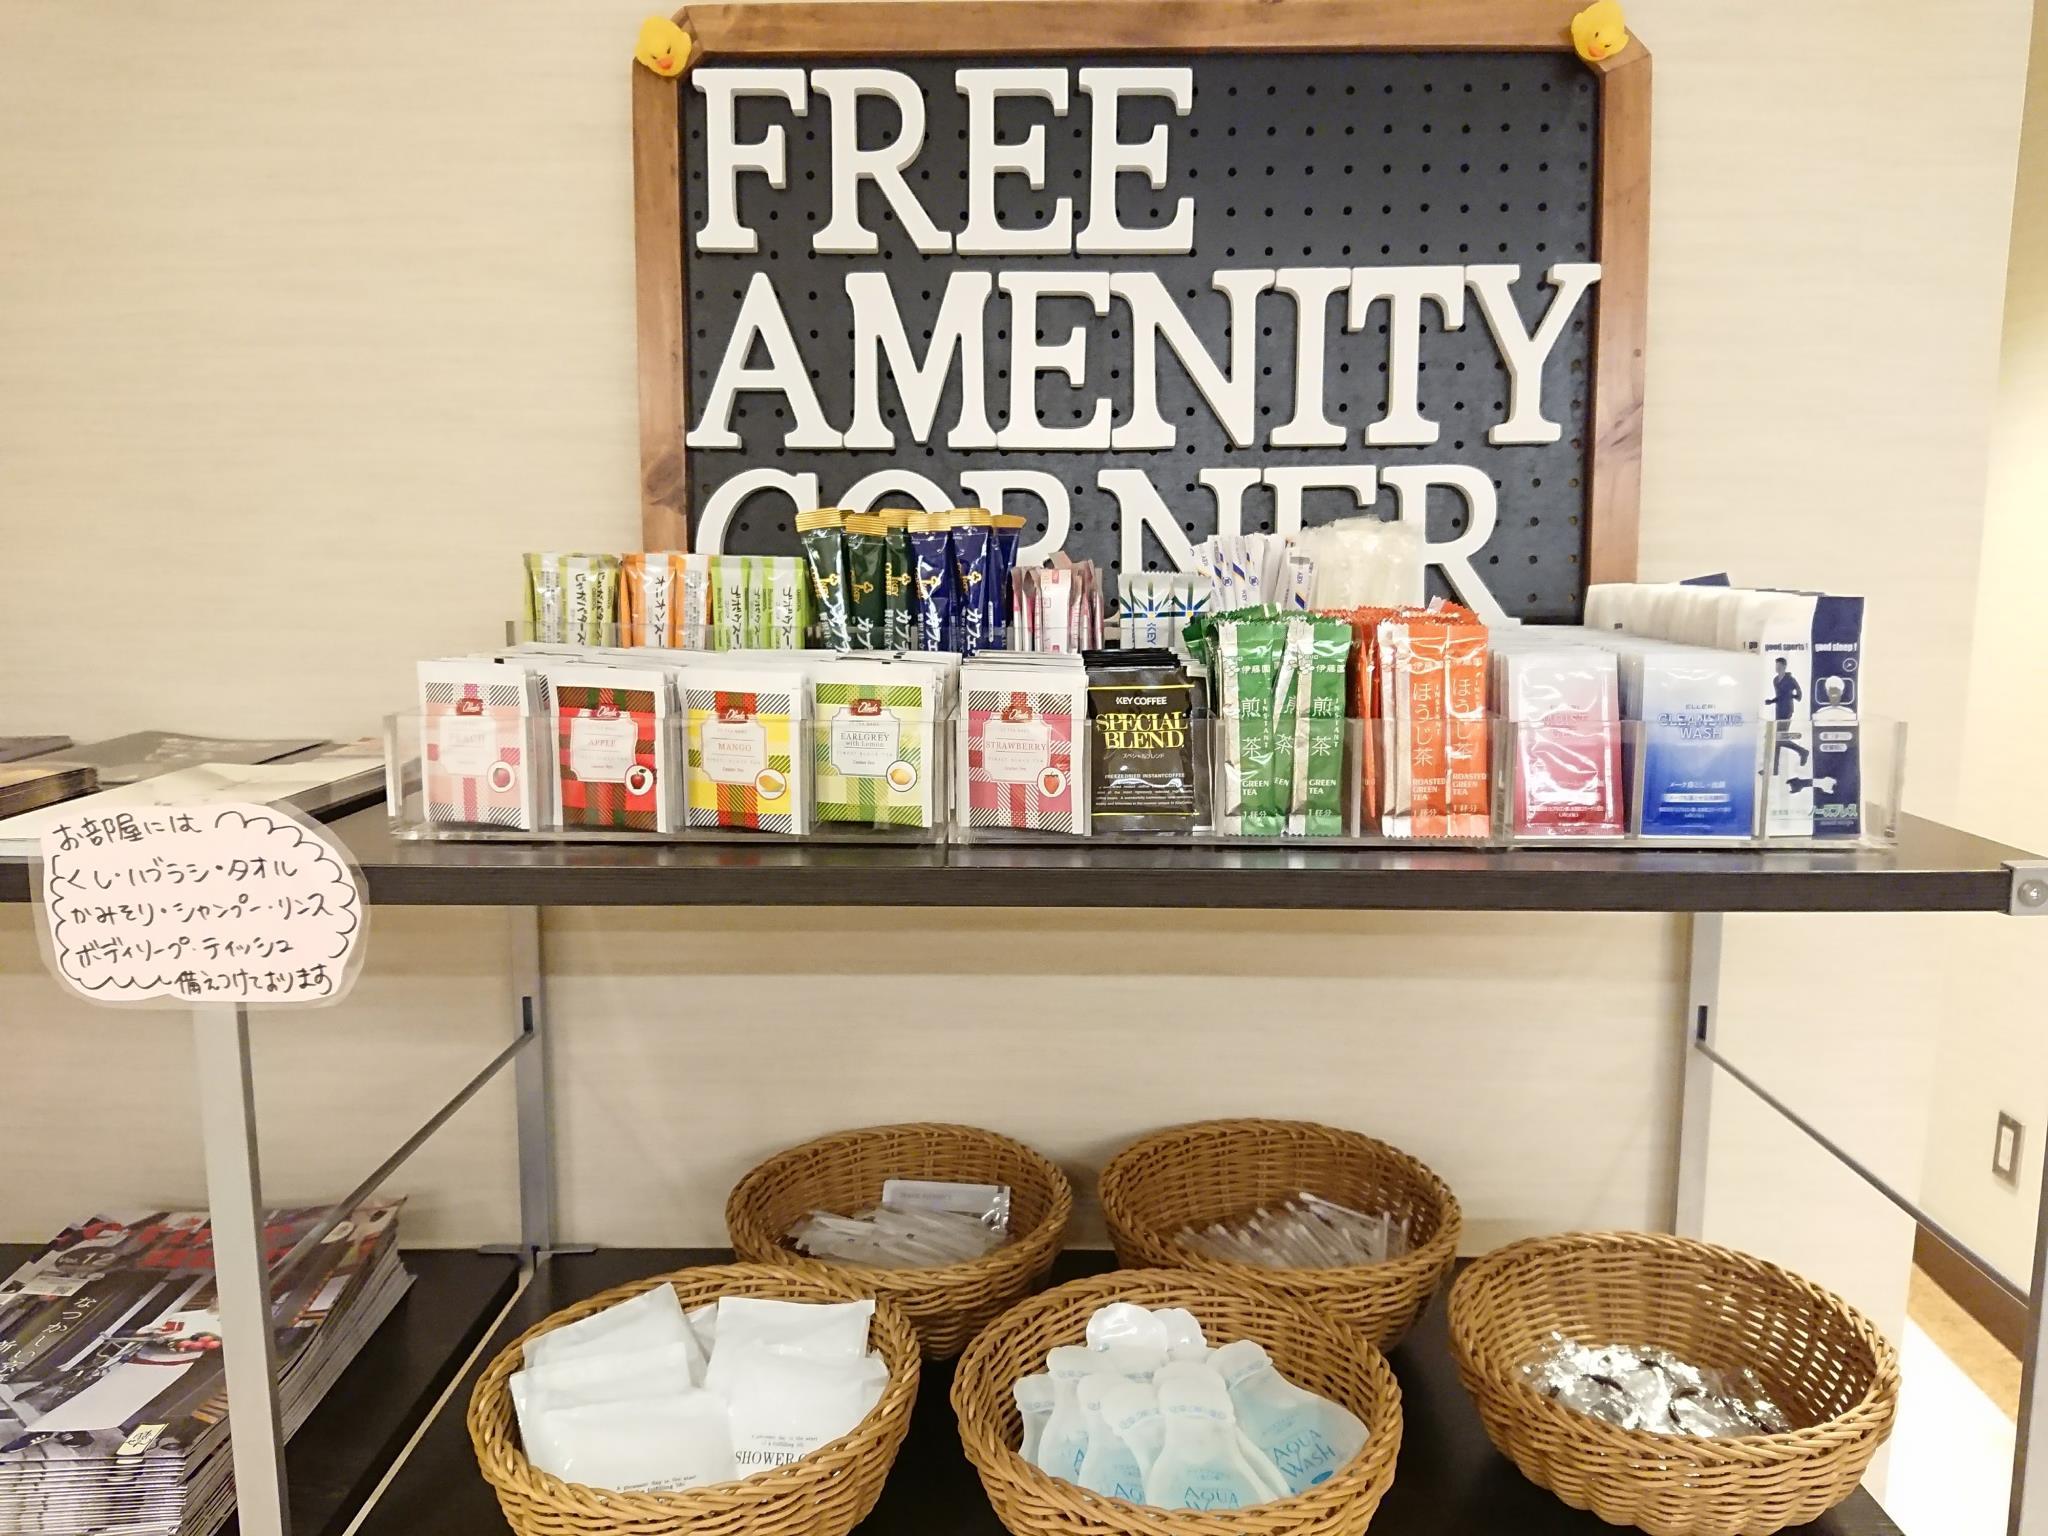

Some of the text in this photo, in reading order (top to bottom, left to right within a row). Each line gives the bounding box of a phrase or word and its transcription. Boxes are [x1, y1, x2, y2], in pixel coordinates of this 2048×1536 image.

[692, 67, 1194, 255] FREE
[685, 261, 1603, 450] AMENITY
[654, 576, 666, 648] オニオンスー
[782, 586, 793, 649] ゴボウスー
[1116, 696, 1168, 706] KEY COFFEE
[1095, 711, 1189, 732] SPECIAL
[1311, 696, 1333, 757] 煎茶
[1412, 682, 1433, 767] ほうじ茶
[1680, 727, 1723, 740] WASH
[718, 743, 752, 752] MANGO
[985, 741, 1047, 751] STRAWBERRY
[1452, 772, 1487, 780] ROASTED
[1308, 779, 1337, 787] GREEN
[1412, 778, 1446, 786] ROASTED
[1452, 780, 1478, 788] GREEN
[1242, 788, 1258, 796] TEA
[1308, 787, 1324, 795] TEA
[1412, 786, 1438, 794] GREEN
[1452, 788, 1468, 796] TEA
[52, 812, 203, 851] お部屋には
[735, 1450, 796, 1466] SHOWER
